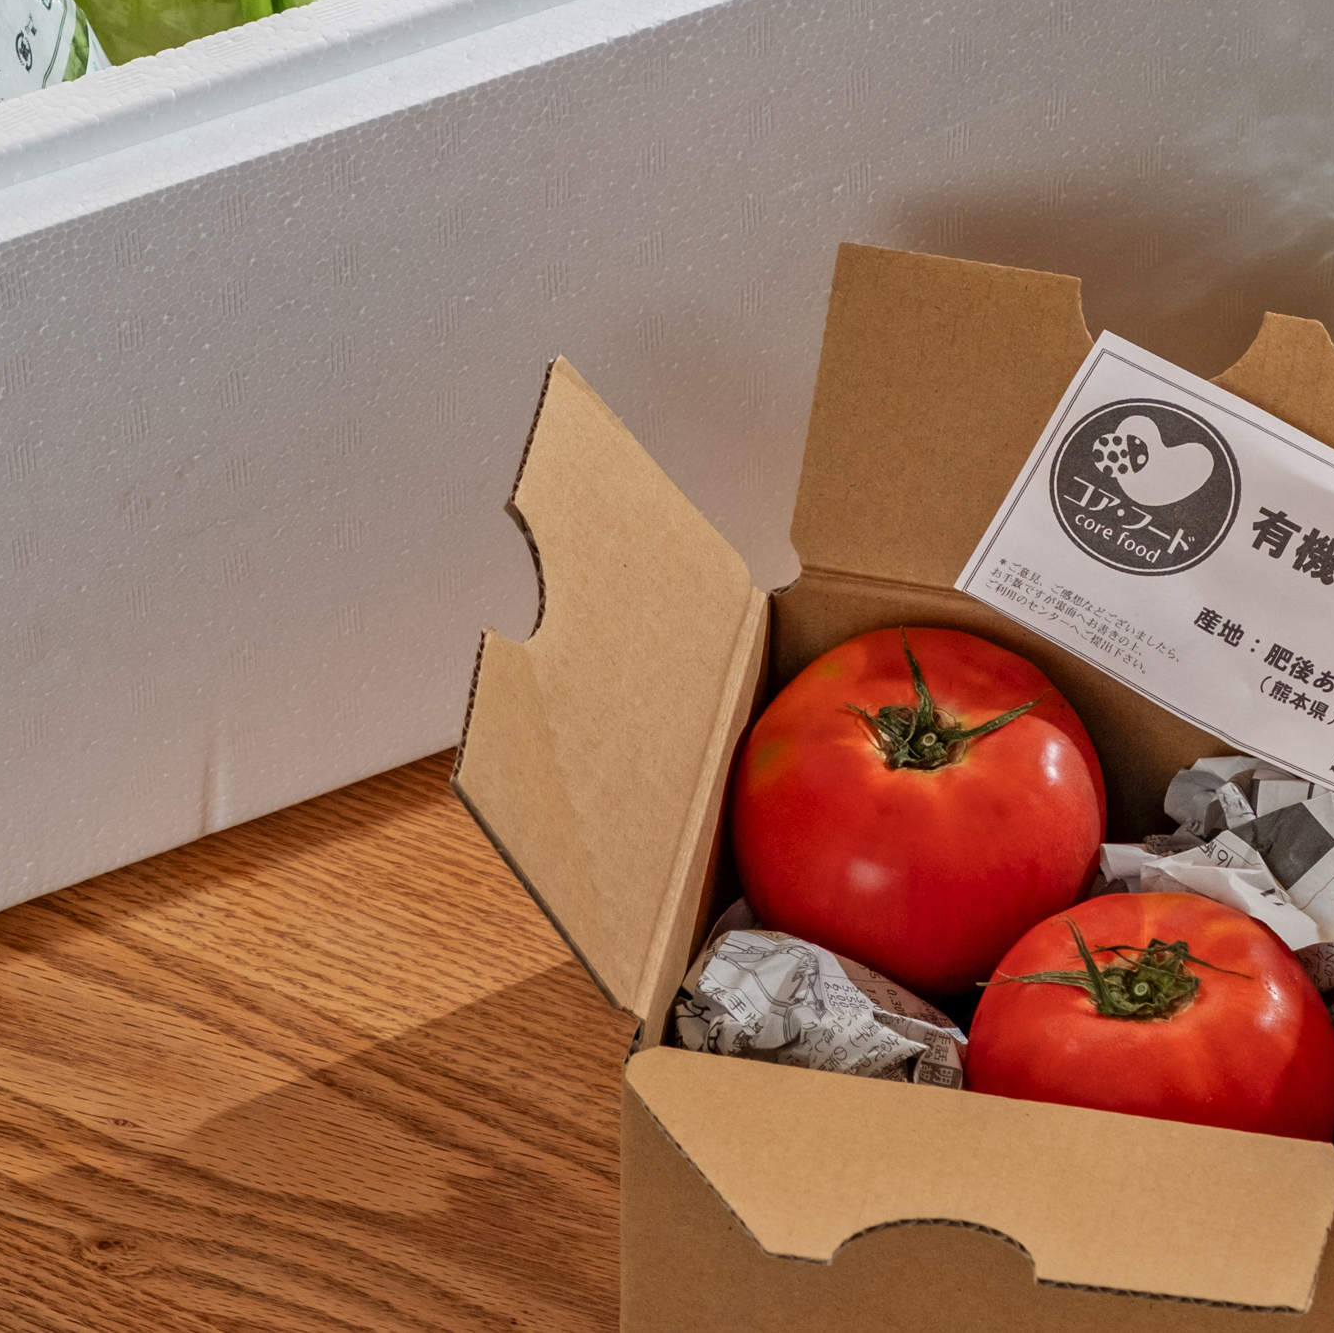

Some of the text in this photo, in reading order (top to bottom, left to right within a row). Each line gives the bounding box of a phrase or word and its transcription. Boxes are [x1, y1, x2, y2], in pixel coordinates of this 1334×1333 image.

[1063, 476, 1196, 556] コア・フード
[1074, 511, 1163, 564] core food
